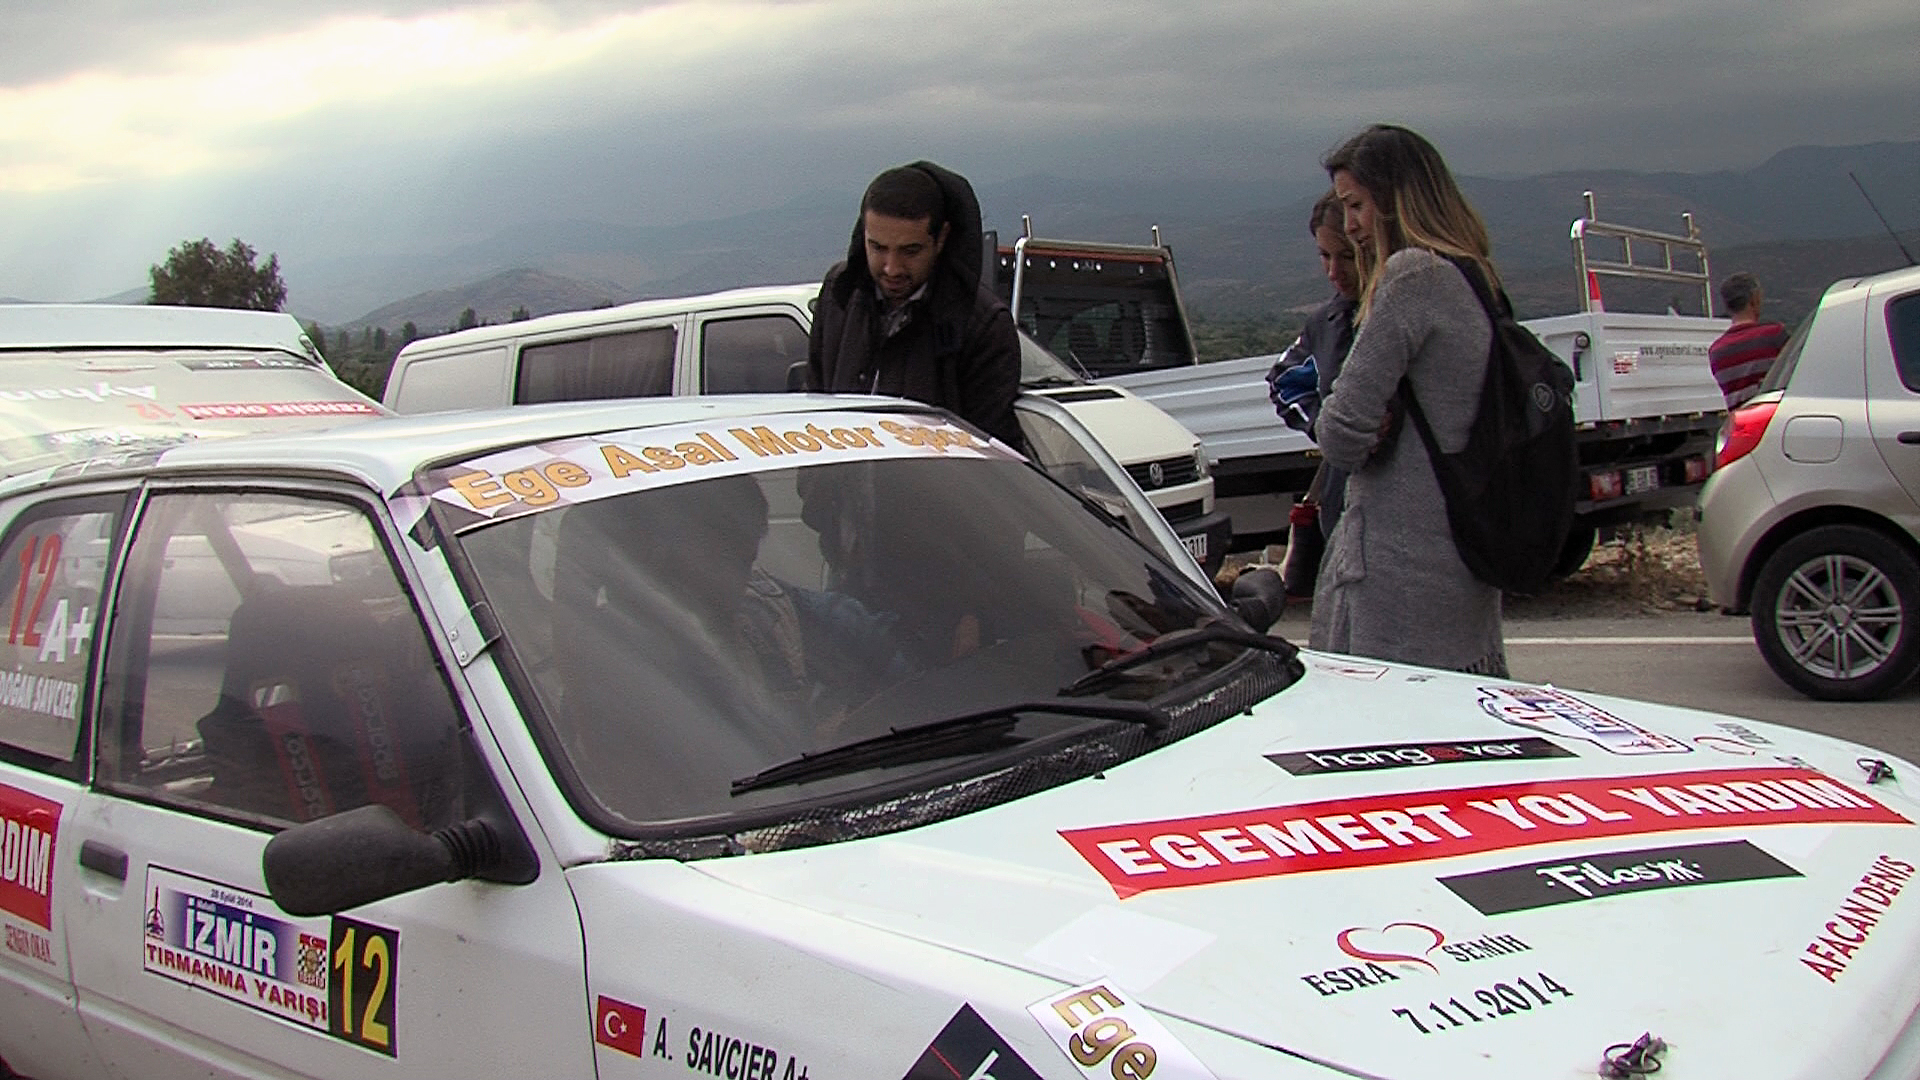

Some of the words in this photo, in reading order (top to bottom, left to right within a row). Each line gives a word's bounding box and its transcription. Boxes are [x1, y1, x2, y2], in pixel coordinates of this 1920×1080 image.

[448, 462, 592, 509] Ege
[600, 432, 735, 479] Asal
[728, 422, 884, 458] Motor
[8, 533, 62, 646] 12
[38, 598, 92, 663] A+
[1096, 804, 1472, 876] EGEMERT
[1468, 793, 1633, 830] YOL
[1607, 778, 1875, 817] YARDIM
[186, 897, 278, 977] İZMİR
[1441, 933, 1533, 963] SEMİH
[1800, 897, 1884, 984] AFACAN
[1853, 855, 1915, 907] DENIS
[147, 943, 248, 994] TIRMANMA
[254, 978, 327, 1022] YARIŞI
[335, 927, 389, 1045] 12
[1301, 962, 1400, 996] ESRA
[1392, 971, 1574, 1034] 7.11.2014
[652, 1016, 673, 1060] A.
[686, 1026, 777, 1080] SAVCIER
[1051, 984, 1157, 1080] Ege
